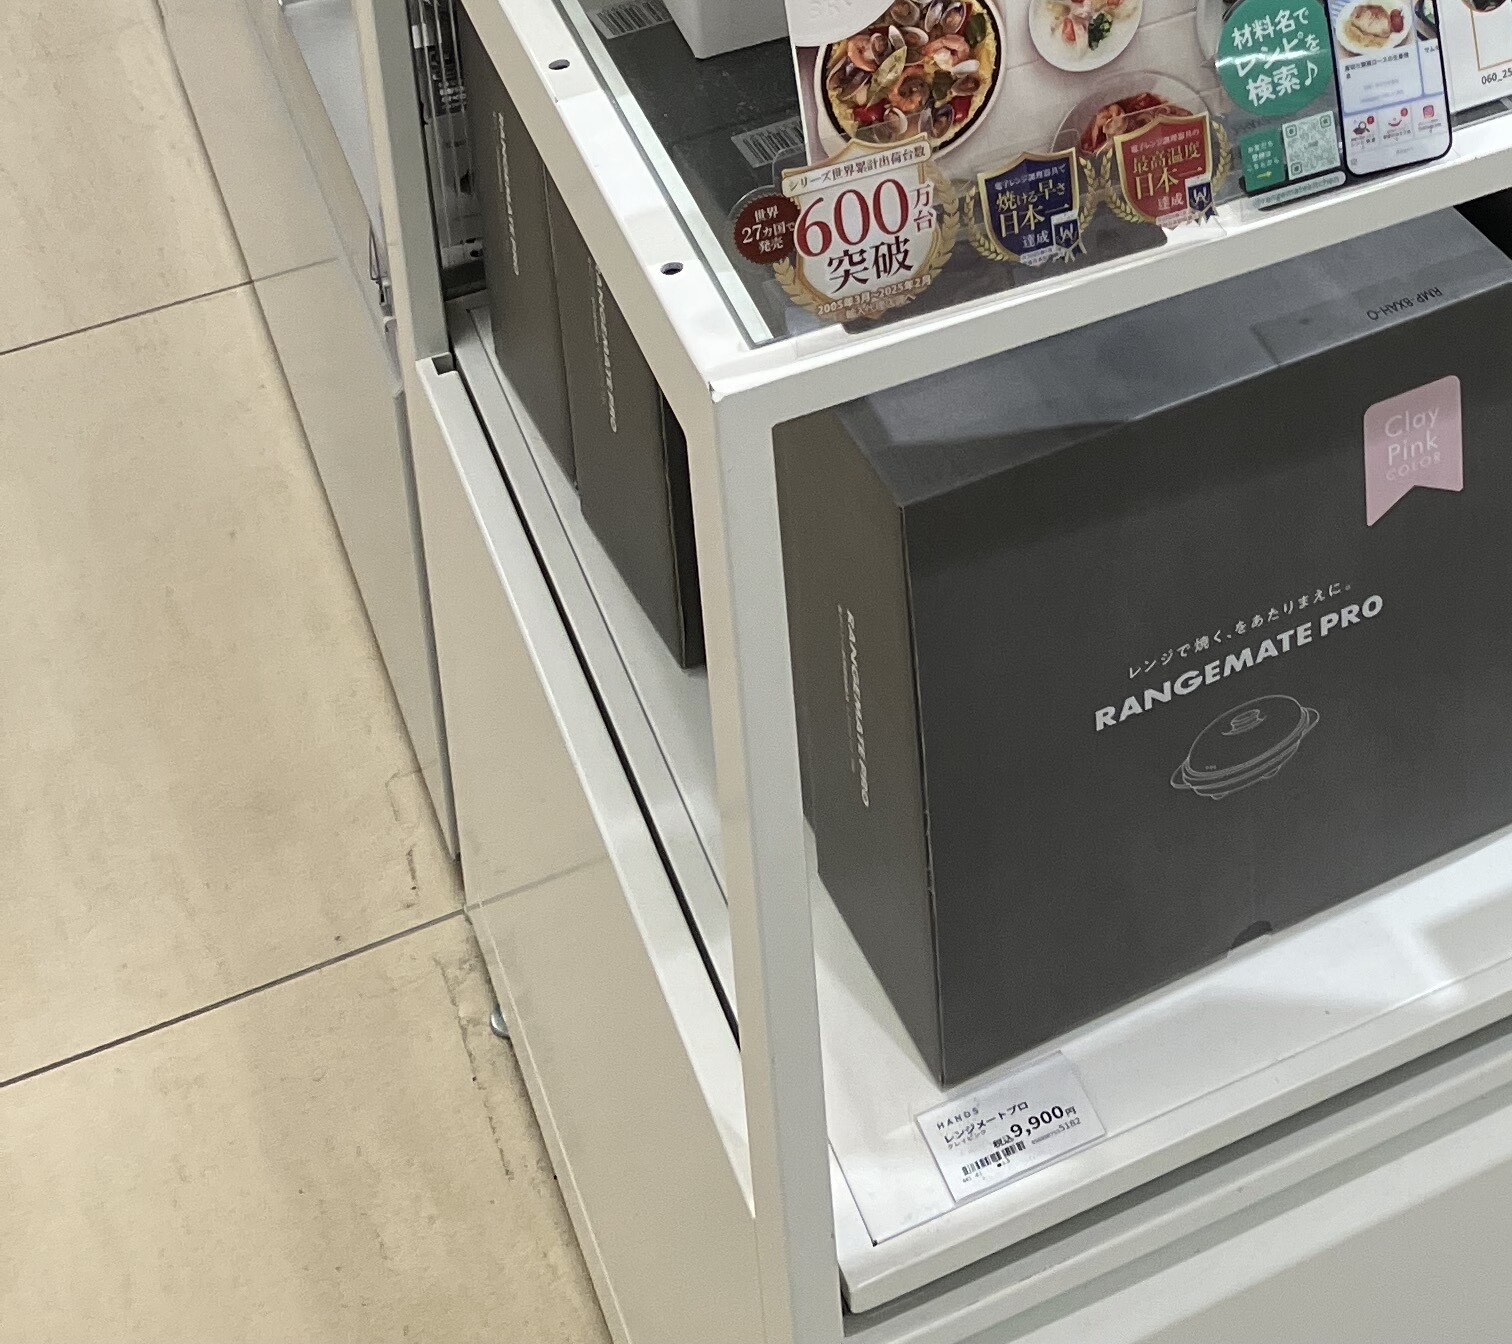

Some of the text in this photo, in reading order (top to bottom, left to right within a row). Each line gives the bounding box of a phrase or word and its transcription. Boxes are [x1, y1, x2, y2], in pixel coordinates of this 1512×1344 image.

[1231, 6, 1310, 50] 材料名で
[786, 147, 927, 190] シリーズ世界累計出荷台数
[1132, 141, 1202, 174] 最高温度
[755, 206, 780, 220] 世界
[794, 177, 911, 259] 600
[1157, 191, 1184, 210] 達成
[758, 234, 785, 253] 発売
[1022, 229, 1050, 249] 達成
[827, 235, 915, 295] 突破
[1383, 403, 1441, 442] Clay
[1385, 430, 1440, 466] Pink
[1385, 452, 1443, 484] COLOR
[1127, 582, 1352, 681] レンジで焼く、をあたりまえに。
[1094, 592, 1385, 733] RANGEMATE PRO
[936, 1106, 979, 1131] HANDS
[943, 1100, 1029, 1144] レンジメートプロ
